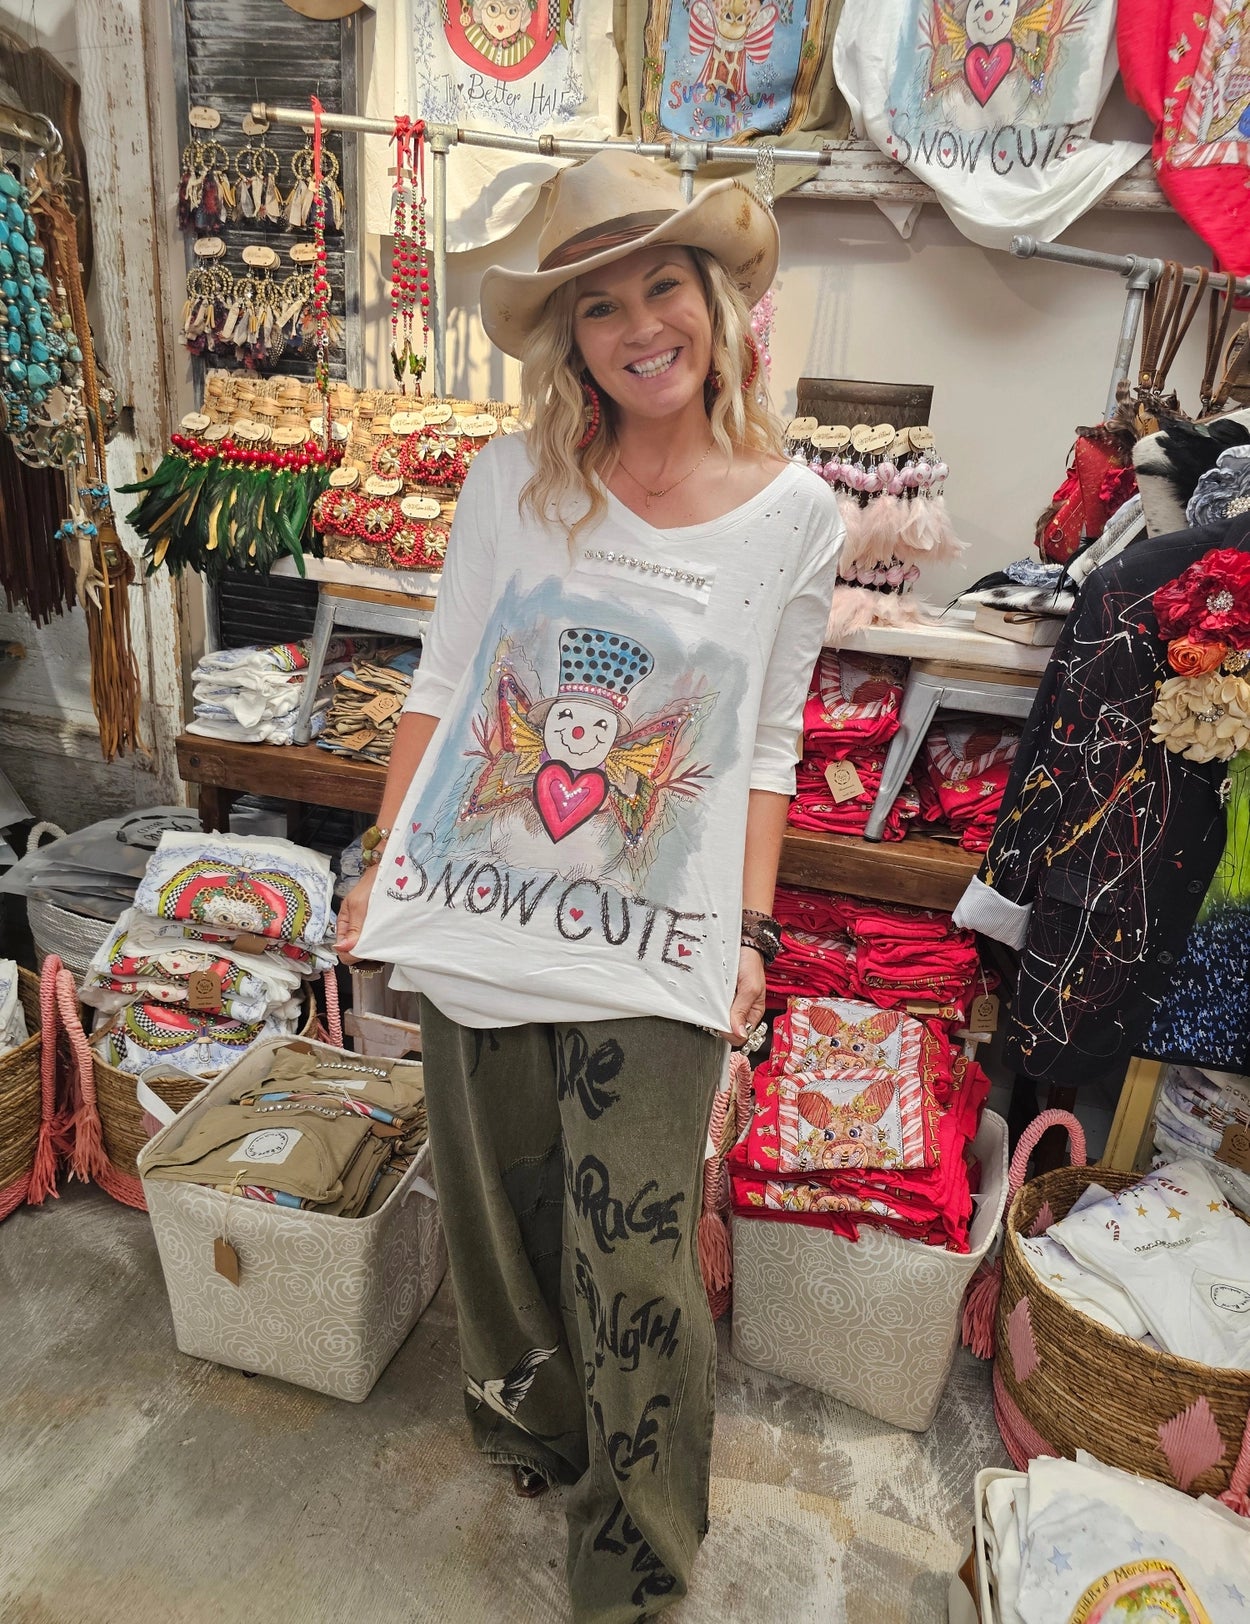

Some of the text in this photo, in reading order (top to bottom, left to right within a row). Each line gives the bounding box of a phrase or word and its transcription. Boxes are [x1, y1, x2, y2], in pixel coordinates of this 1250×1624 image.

[891, 112, 1093, 176] SNOW CUTE
[386, 831, 706, 972] SNOW CUTE
